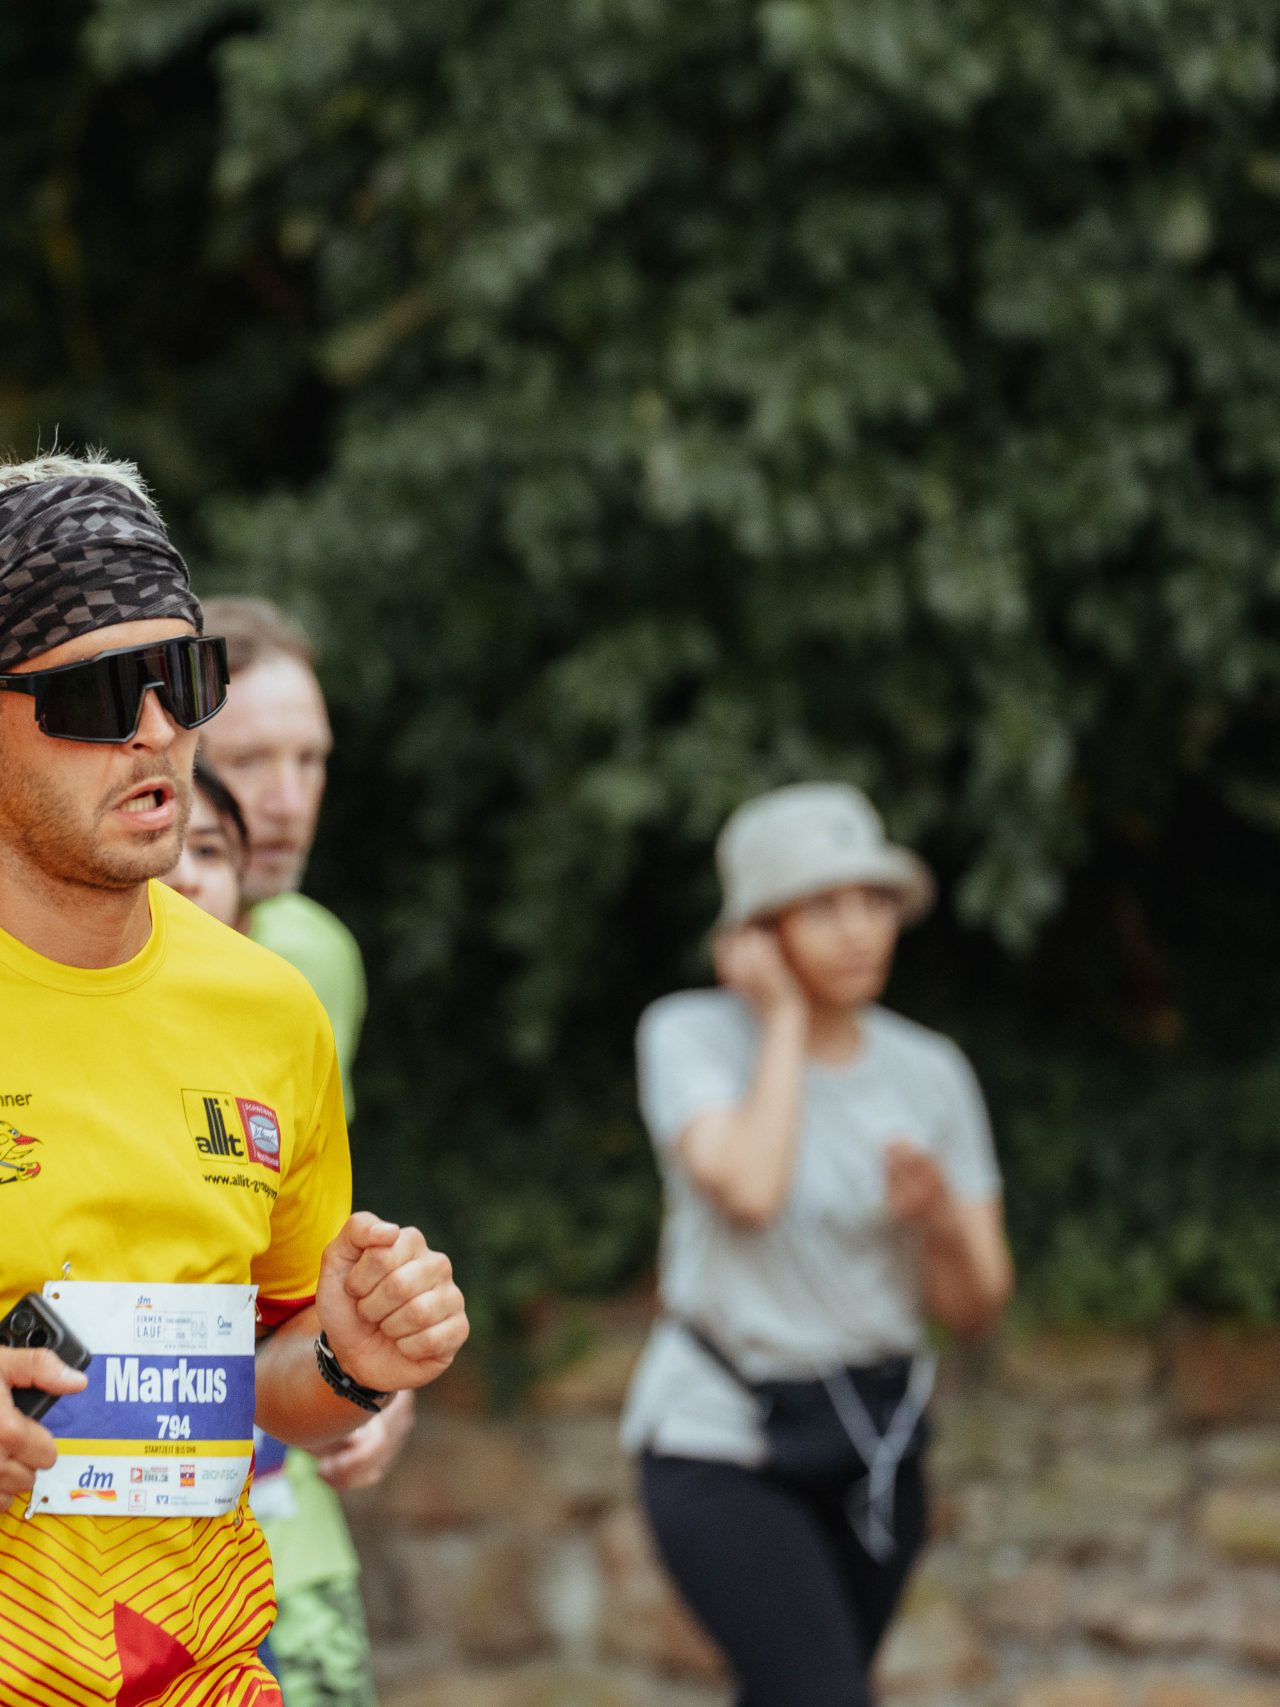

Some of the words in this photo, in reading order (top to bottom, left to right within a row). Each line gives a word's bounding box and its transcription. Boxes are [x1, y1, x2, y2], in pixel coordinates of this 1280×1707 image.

[195, 1097, 244, 1157] allit
[136, 1326, 162, 1338] LAUF
[105, 1357, 228, 1404] Markus
[156, 1414, 191, 1440] 794
[78, 1465, 114, 1489] dm
